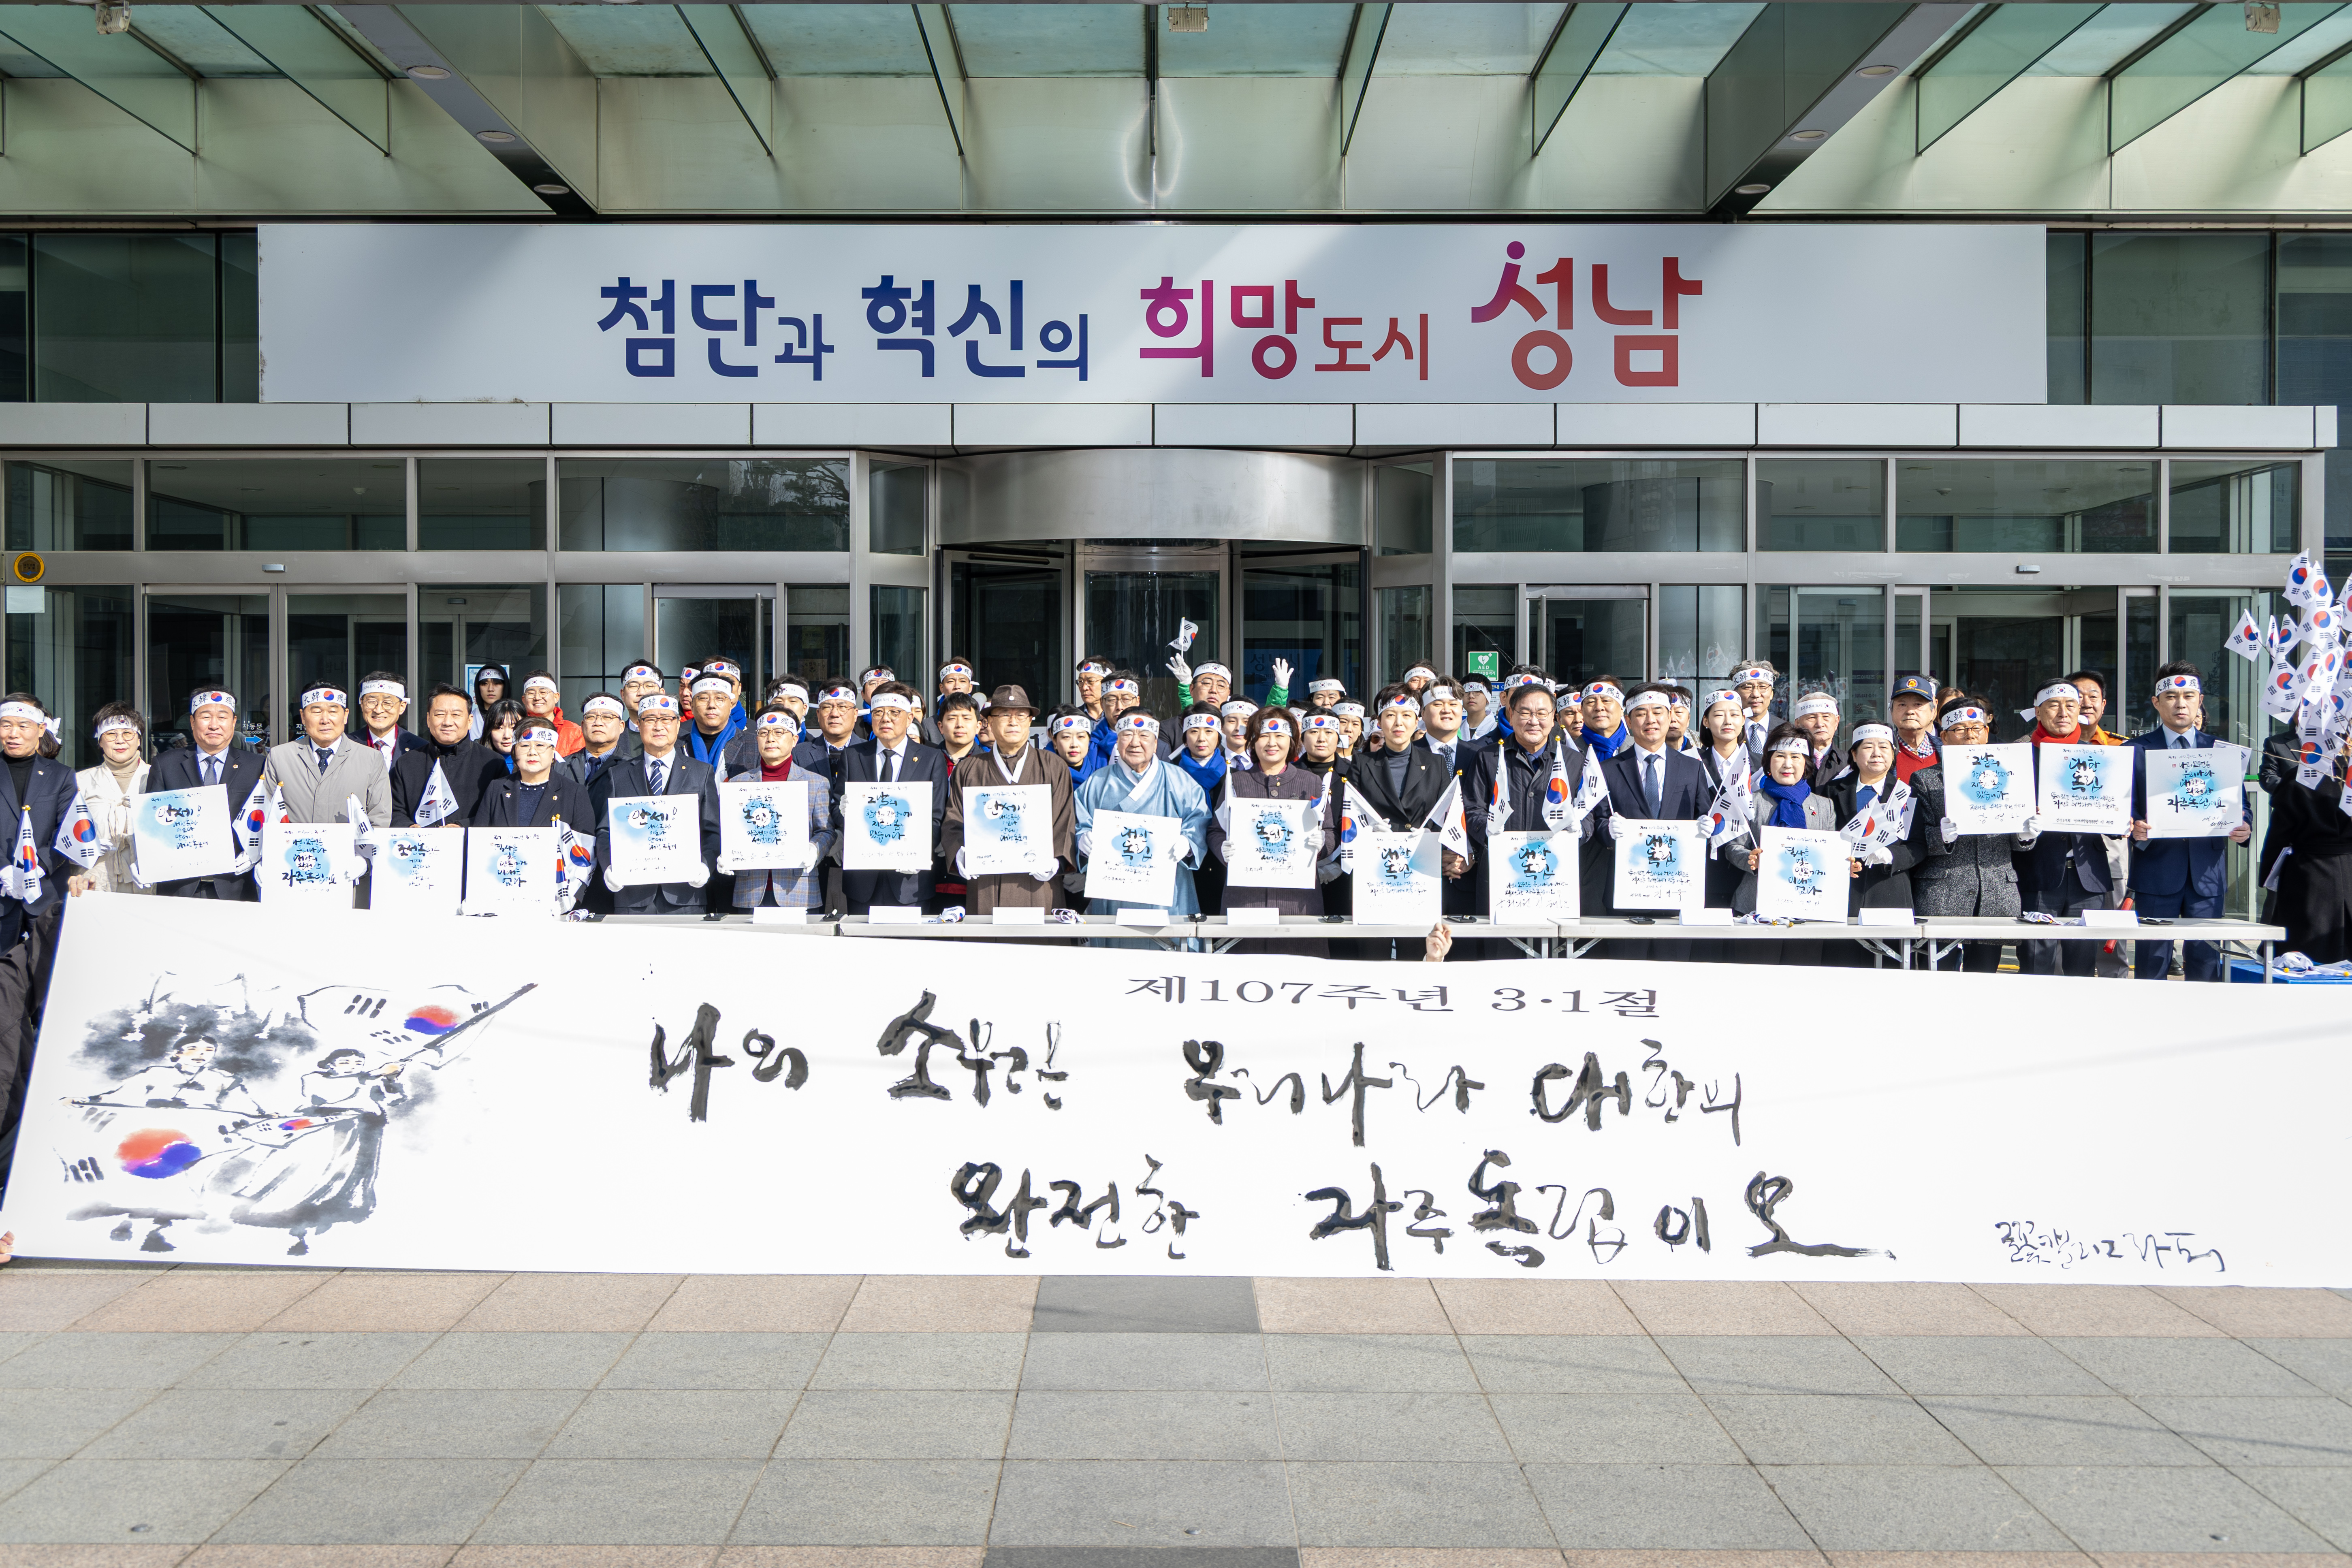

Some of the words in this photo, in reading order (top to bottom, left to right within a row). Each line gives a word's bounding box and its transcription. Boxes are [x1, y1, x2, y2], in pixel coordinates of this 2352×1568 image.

[597, 277, 834, 381] 첨단과
[862, 275, 1088, 381] 혁신의
[1140, 276, 1428, 381] 희망도시
[1471, 241, 1702, 390] 성남
[941, 666, 952, 678] 大韓
[1733, 671, 1747, 685] 大韓
[1505, 676, 1521, 687] 大韓
[2157, 678, 2172, 693] 大韓
[193, 693, 209, 708] 大韓
[303, 691, 321, 706] 大韓
[843, 690, 855, 701] 獨立
[1605, 687, 1620, 700] 獨立
[1705, 691, 1721, 707] 大韓
[640, 697, 657, 709] 大韓
[1557, 695, 1571, 708] 大韓
[781, 717, 794, 729] 獨立
[1077, 718, 1089, 729] 獨立
[1117, 717, 1130, 730] 大韓
[1186, 716, 1202, 727] 大韓
[1946, 709, 1965, 725] 大韓
[536, 731, 553, 741] 獨立
[1972, 753, 2000, 768] 그날의
[2069, 756, 2100, 772] 대한
[2182, 768, 2215, 778] 우리나라
[2071, 771, 2103, 793] 독립
[2180, 779, 2205, 787] 대한의
[1976, 791, 2009, 800] 있습니다
[2186, 787, 2214, 796] 완전한
[868, 791, 897, 809] 그날의
[870, 830, 905, 843] 있습니다
[1121, 825, 1153, 843] 대한
[1256, 821, 1293, 841] 독립한
[1646, 834, 1676, 847] 대한
[1122, 840, 1153, 862] 독립
[1382, 846, 1411, 860] 대한
[1519, 845, 1551, 860] 대한
[1647, 847, 1676, 868] 독립
[1785, 846, 1809, 857] 역사를
[1384, 860, 1413, 879] 독립
[1522, 860, 1555, 880] 독립
[1795, 867, 1826, 877] 민족에게
[1789, 877, 1812, 886] 미래는
[1795, 886, 1822, 896] 없다
[1125, 975, 1454, 1012] 제107주년
[649, 1002, 809, 1123] 나의
[877, 988, 1069, 1111] 소원은
[1182, 1038, 1486, 1148] 우리나라
[1529, 1037, 1742, 1147] 대한의
[950, 1154, 1201, 1260] 완전한
